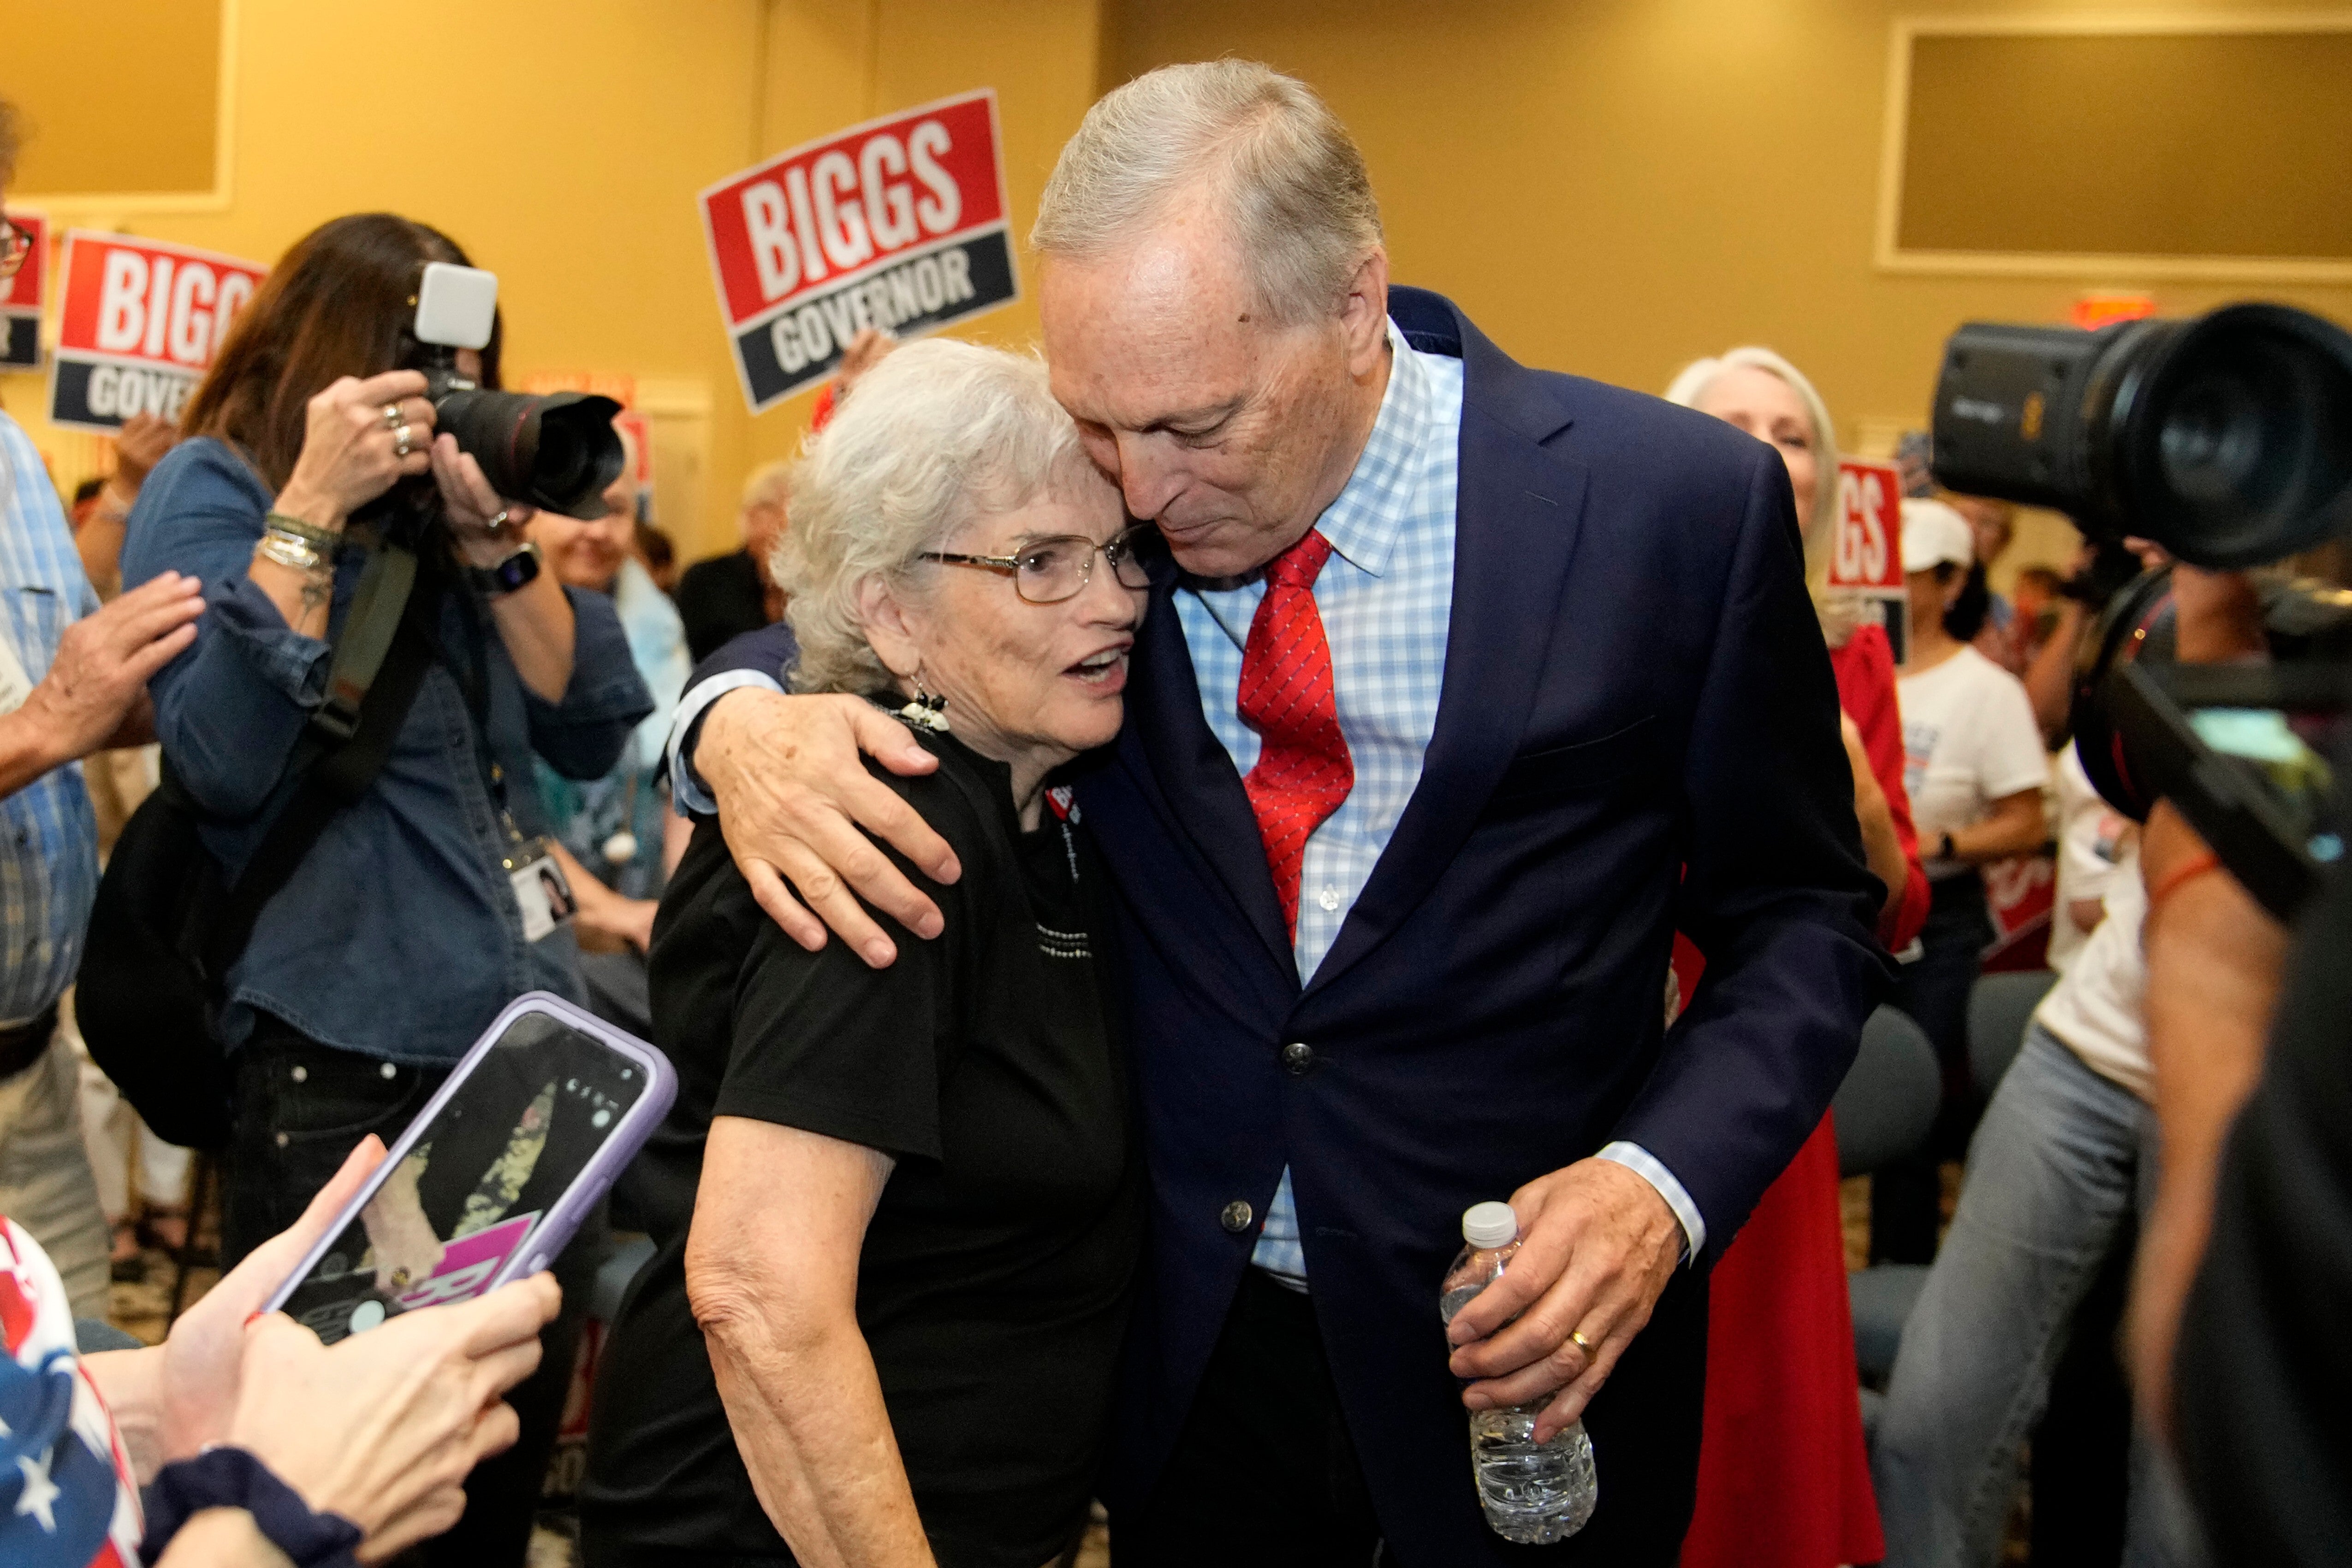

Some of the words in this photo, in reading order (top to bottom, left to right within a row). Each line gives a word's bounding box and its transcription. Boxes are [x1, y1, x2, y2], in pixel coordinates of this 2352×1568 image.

[742, 120, 962, 303] BIGGS
[95, 249, 255, 363] BIGG
[770, 247, 976, 374] GOVERNOR
[86, 367, 199, 425] GOVE
